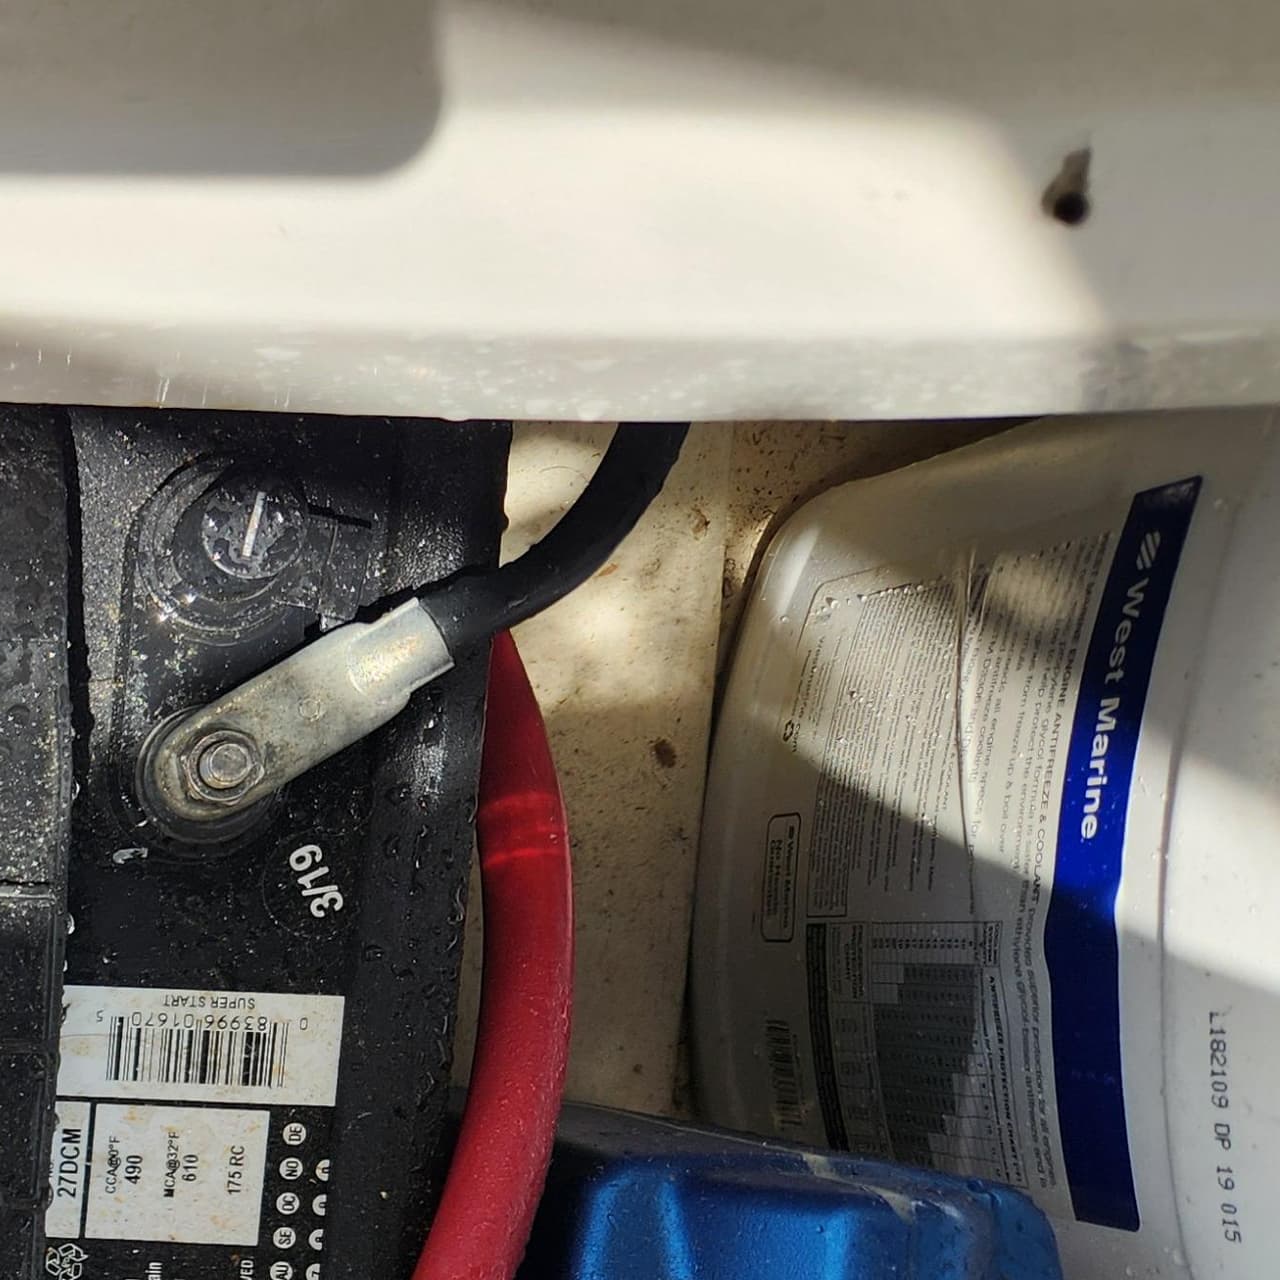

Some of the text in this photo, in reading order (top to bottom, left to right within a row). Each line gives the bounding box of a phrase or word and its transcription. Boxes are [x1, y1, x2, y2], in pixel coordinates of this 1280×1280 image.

[1081, 577, 1149, 840] West Marine
[1039, 713, 1062, 810] ANTIFREEZE
[289, 845, 343, 918] 3/19
[1029, 829, 1045, 905] COOLANT
[131, 1011, 195, 1028] 01670
[163, 994, 255, 1009] SUPER START
[203, 1013, 267, 1030] 83996
[57, 1127, 81, 1197] 27DCM
[124, 1154, 142, 1184] 490
[182, 1154, 198, 1181] 610
[227, 1145, 244, 1194] 175 RC
[1217, 1166, 1234, 1190] 19
[1221, 1203, 1241, 1243] 015
